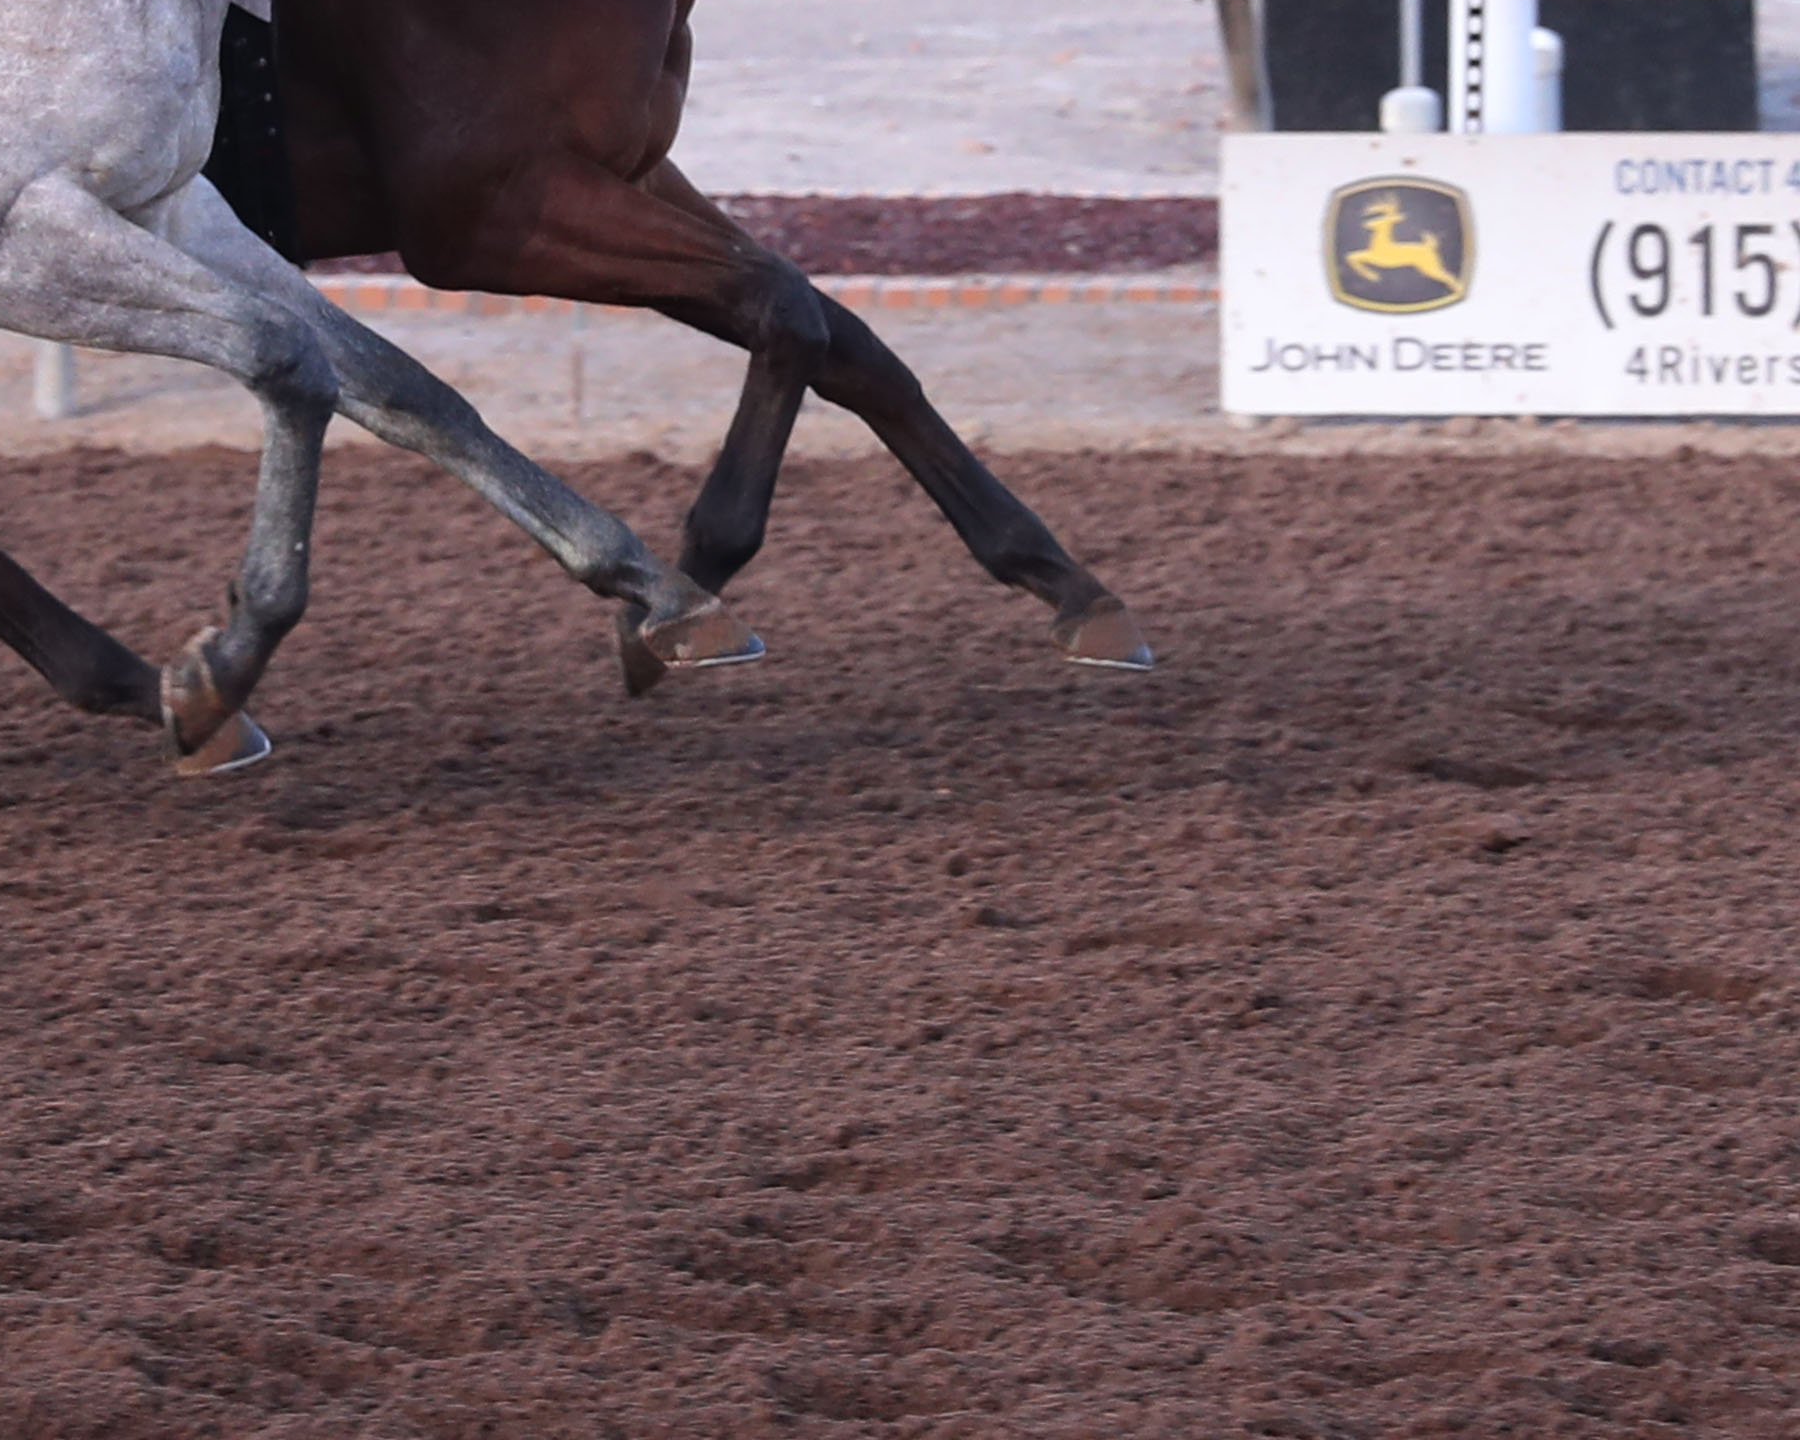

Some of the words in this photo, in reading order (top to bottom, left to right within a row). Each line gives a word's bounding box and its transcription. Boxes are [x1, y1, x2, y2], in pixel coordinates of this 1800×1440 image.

[1615, 159, 1775, 196] CONTACT
[1250, 342, 1377, 372] JOHN
[1392, 337, 1548, 371] DEERE
